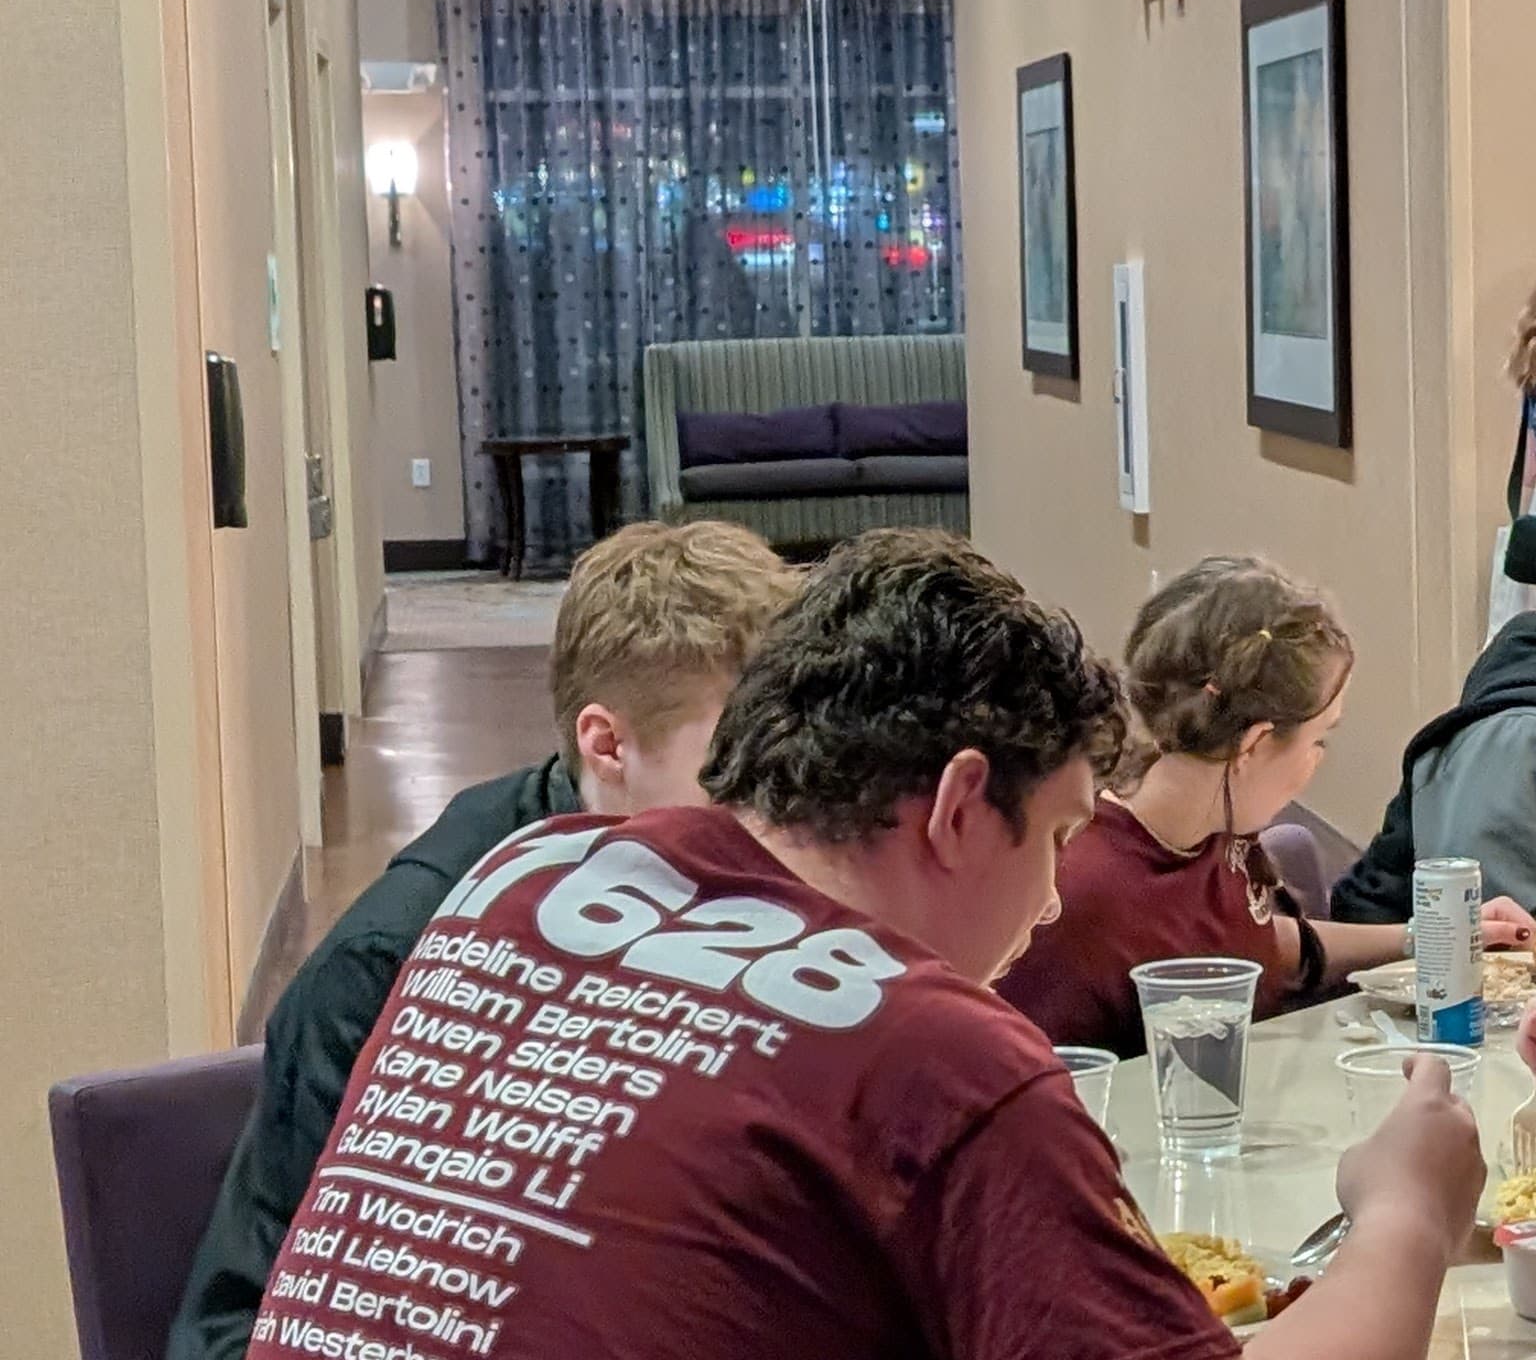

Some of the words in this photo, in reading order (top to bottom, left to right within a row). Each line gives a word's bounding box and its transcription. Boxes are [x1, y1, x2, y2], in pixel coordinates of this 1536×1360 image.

[404, 967, 523, 1024] William
[525, 1004, 735, 1075] Bertolini
[411, 931, 563, 992] Madeline
[568, 975, 788, 1056] Reichert
[372, 1045, 464, 1088] Kane
[466, 1070, 635, 1135] Nelsen
[392, 1007, 501, 1059] Owen
[507, 1041, 663, 1097] Siders
[355, 1085, 453, 1129] Rylan
[464, 1108, 604, 1165] Wolff
[360, 1193, 522, 1261] Wodrich
[523, 1168, 581, 1208] Li
[343, 1238, 516, 1307] Liebnow
[329, 1282, 499, 1354] Bertolini
